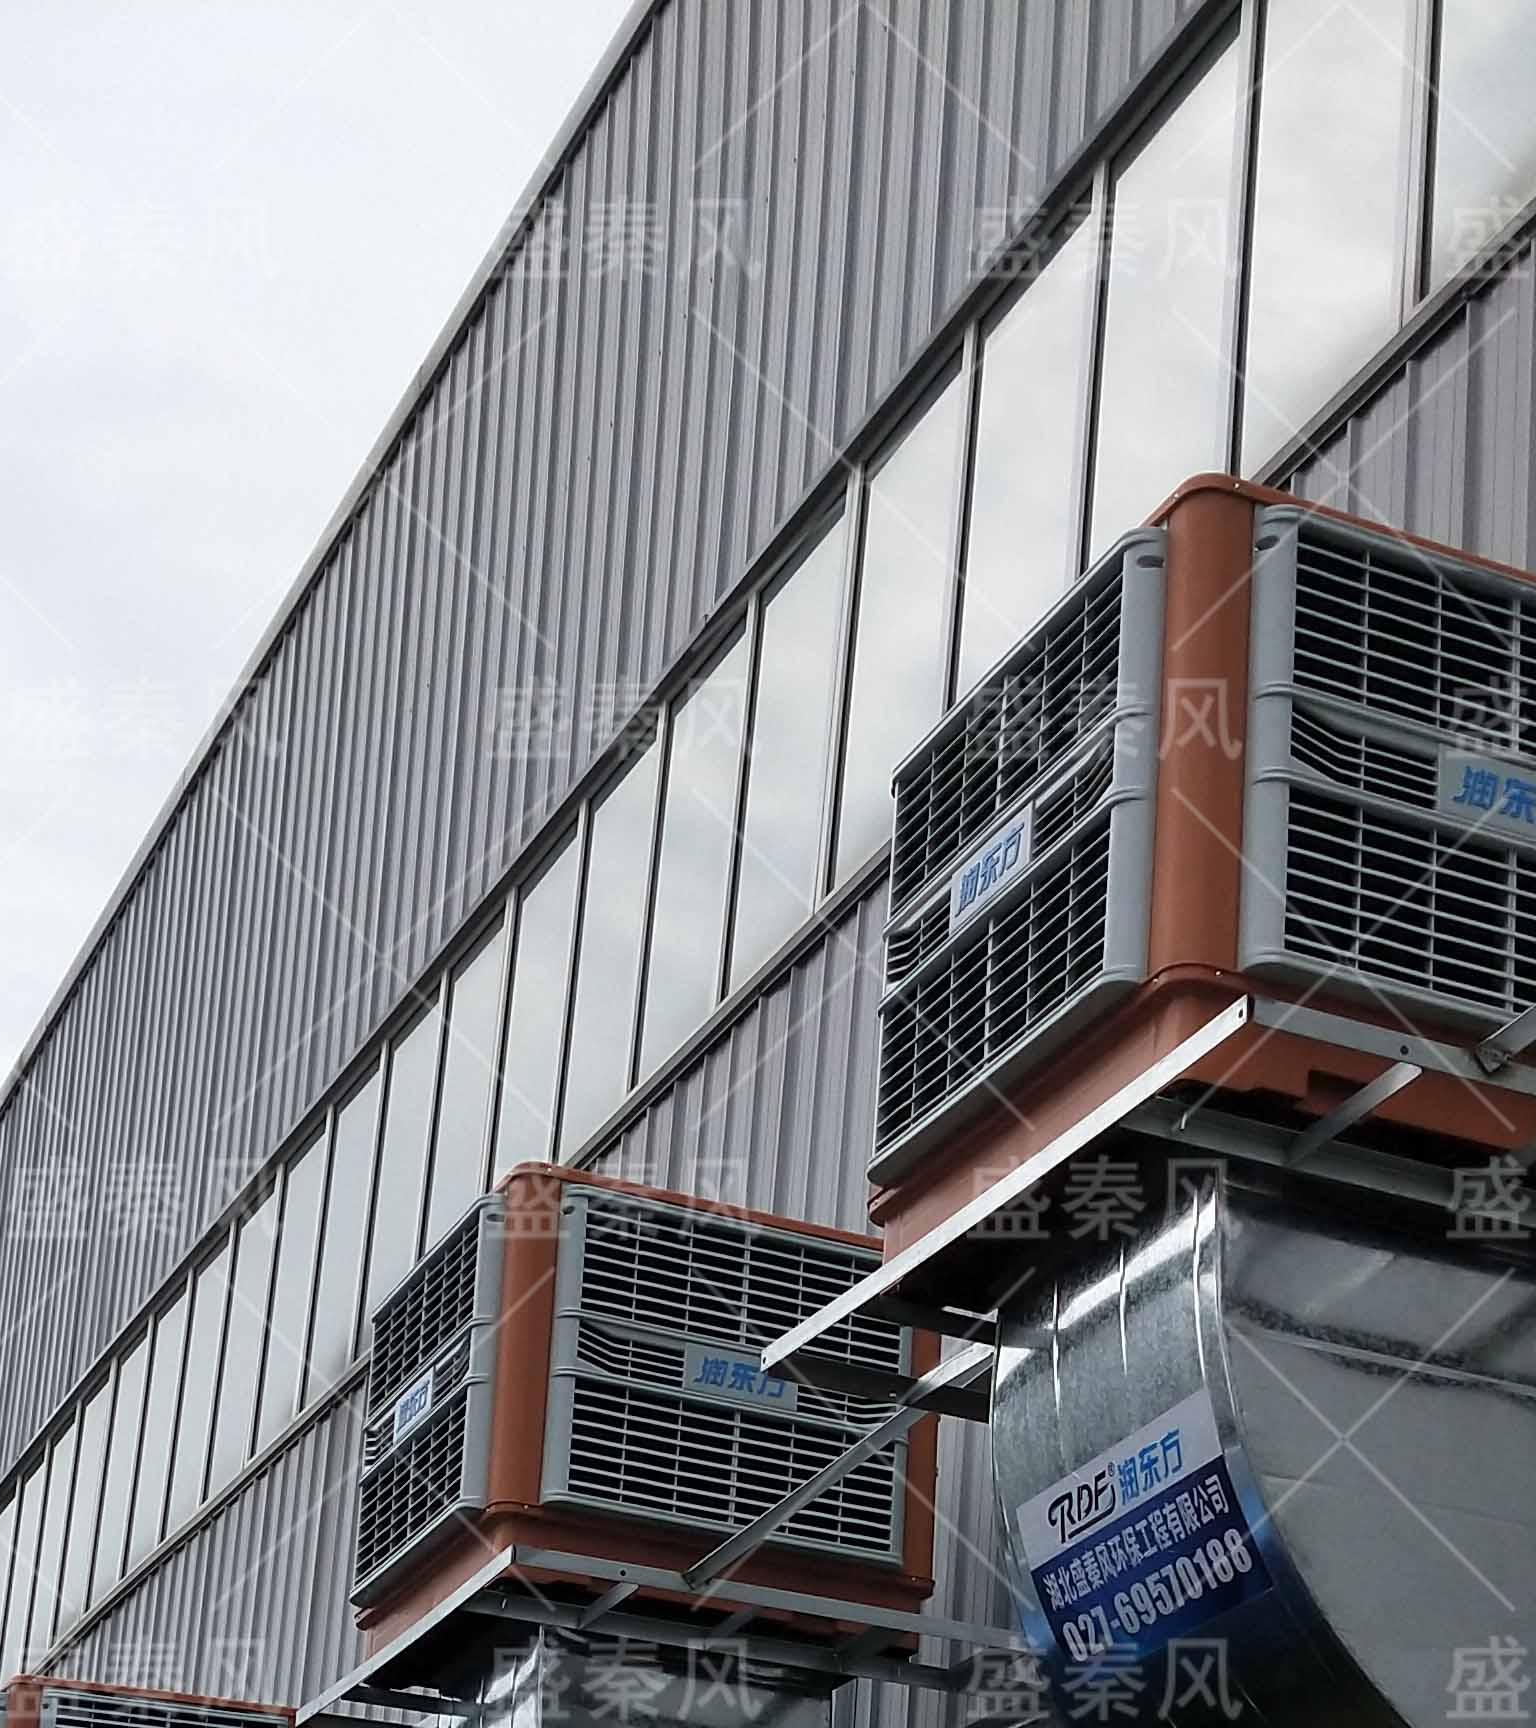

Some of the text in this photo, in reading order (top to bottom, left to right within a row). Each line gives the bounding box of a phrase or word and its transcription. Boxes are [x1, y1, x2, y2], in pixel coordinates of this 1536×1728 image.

[955, 822, 1025, 918] 润东方
[1117, 1428, 1183, 1505] 润东方
[1062, 1528, 1252, 1662] 027-69570188
